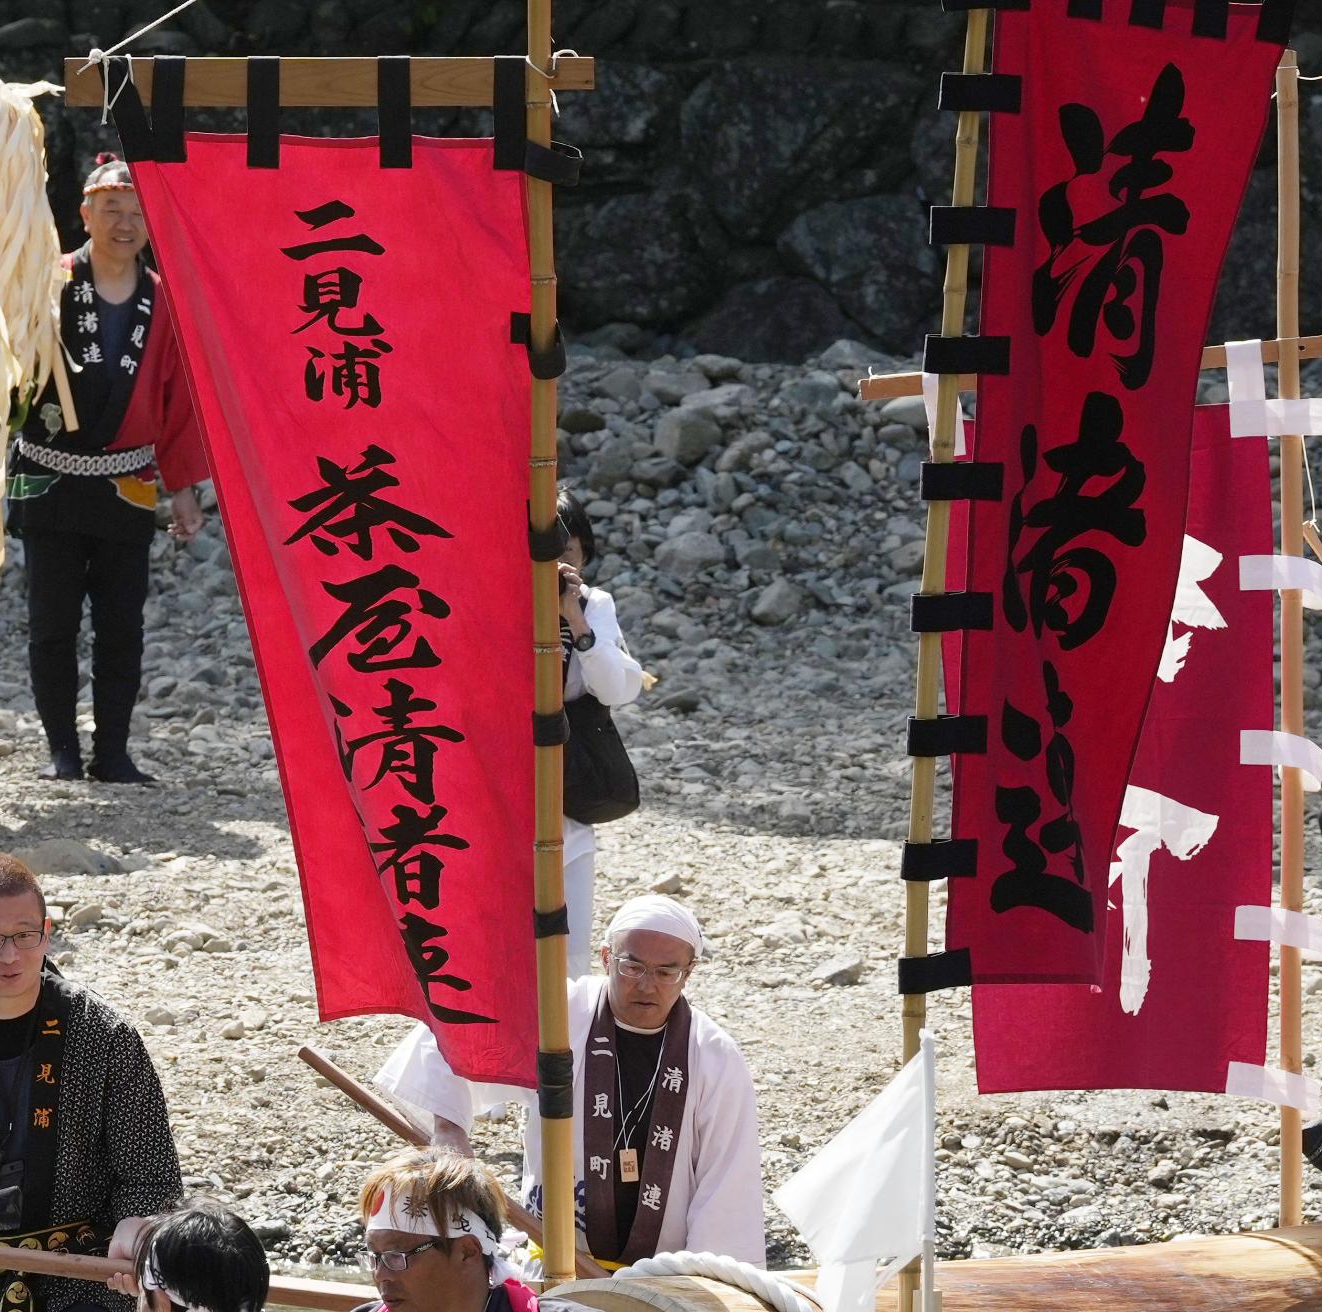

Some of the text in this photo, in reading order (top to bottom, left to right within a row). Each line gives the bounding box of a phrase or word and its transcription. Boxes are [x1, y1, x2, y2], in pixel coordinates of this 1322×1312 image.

[72, 279, 105, 365] 清渚連
[119, 296, 153, 376] 二見町
[278, 199, 395, 411] 二見浦
[32, 1018, 62, 1129] 二見浦
[588, 1035, 614, 1181] 二見町
[640, 1065, 685, 1212] 清渚連
